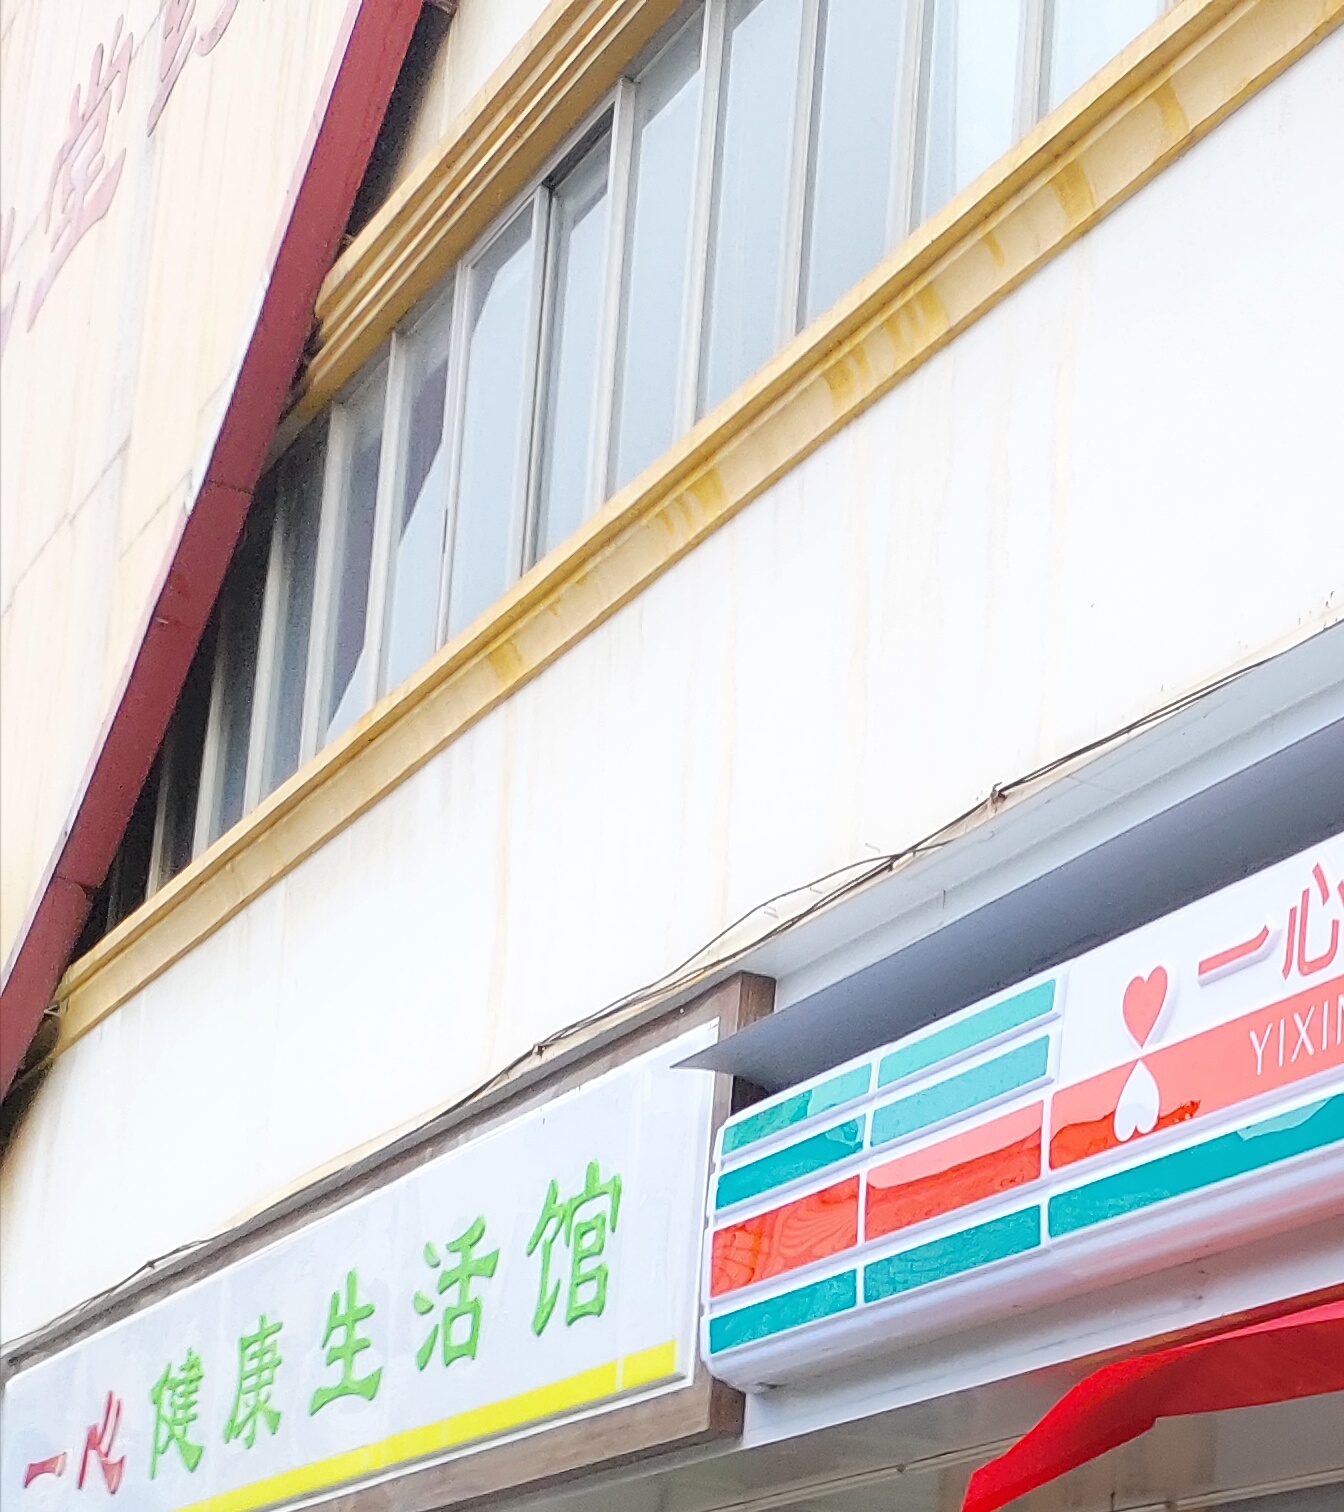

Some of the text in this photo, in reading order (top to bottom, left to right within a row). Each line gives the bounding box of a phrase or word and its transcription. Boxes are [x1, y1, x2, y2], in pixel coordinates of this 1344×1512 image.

[150, 1159, 623, 1481] 健康生活馆
